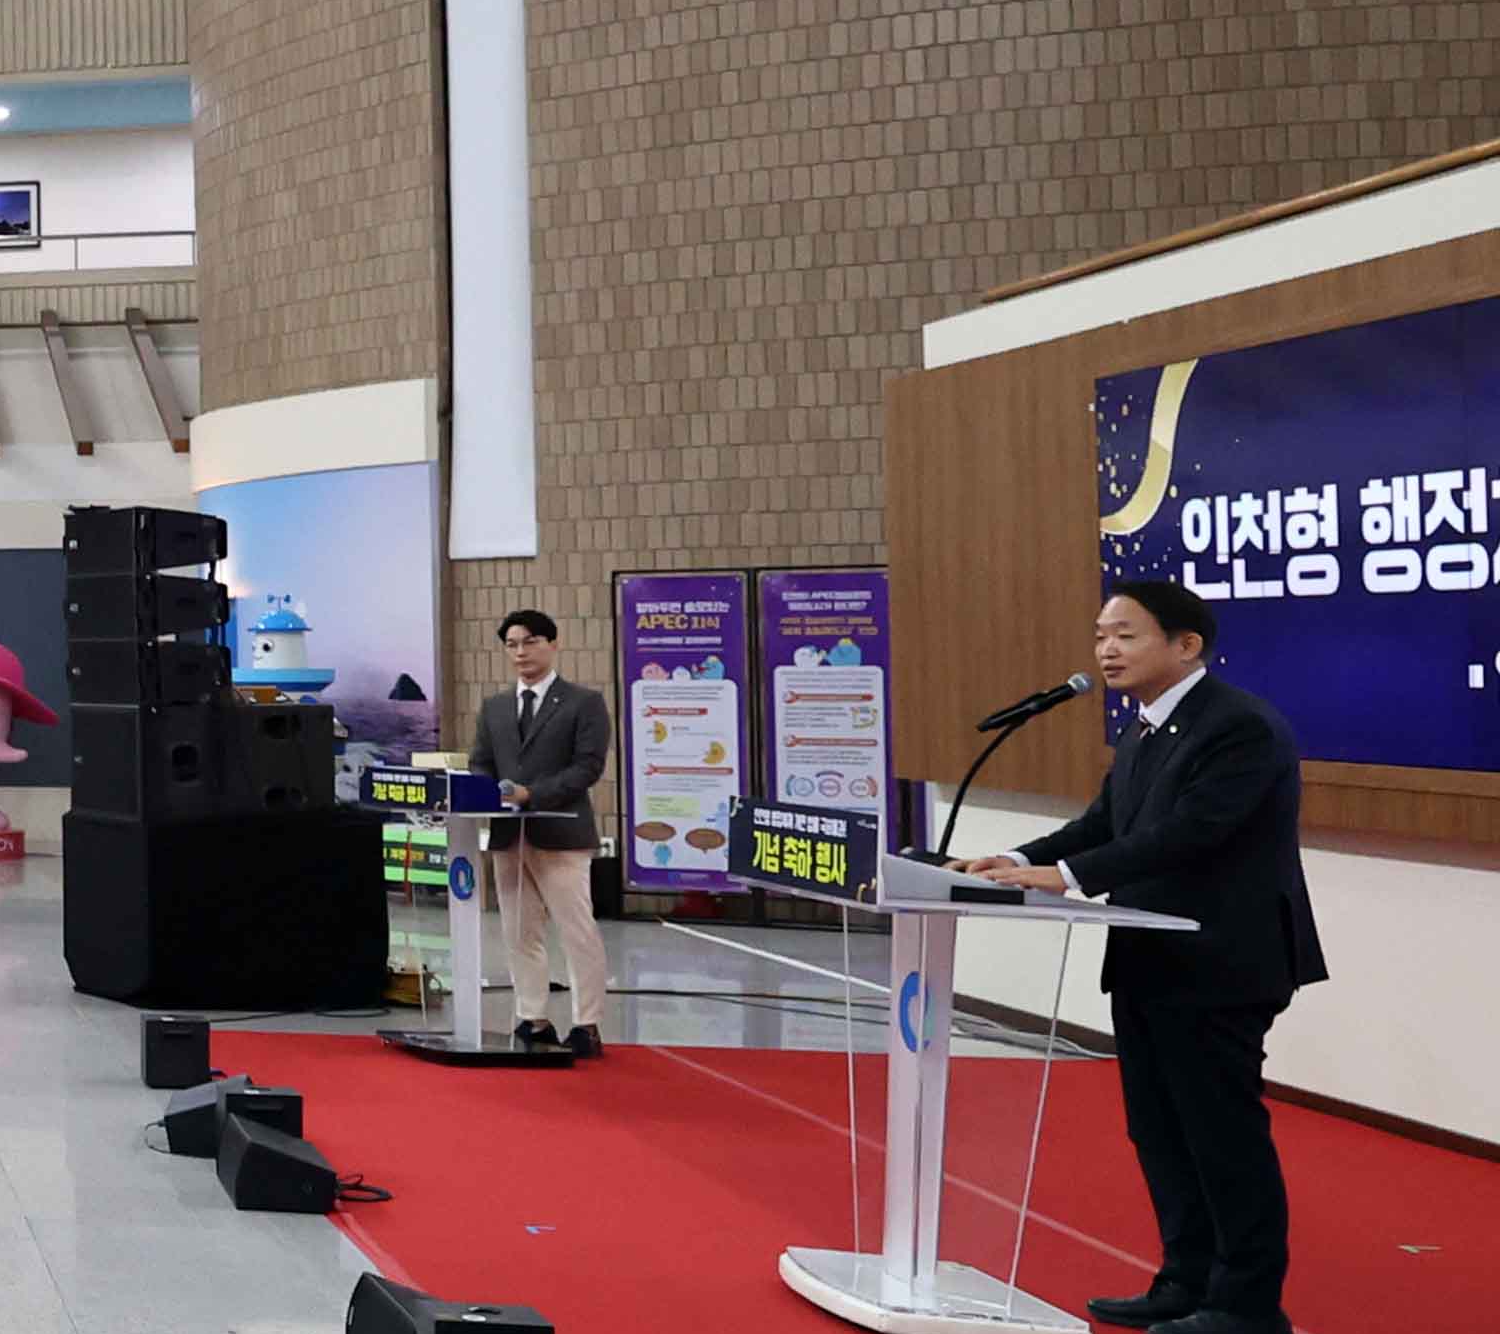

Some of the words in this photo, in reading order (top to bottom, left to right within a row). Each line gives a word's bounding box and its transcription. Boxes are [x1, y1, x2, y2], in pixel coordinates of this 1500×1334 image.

[1181, 483, 1341, 600] 인천형
[1359, 466, 1500, 594] 행정
[636, 614, 689, 630] APEC
[752, 830, 780, 874] 기념
[783, 835, 813, 879] 축하
[815, 841, 846, 887] 행사
